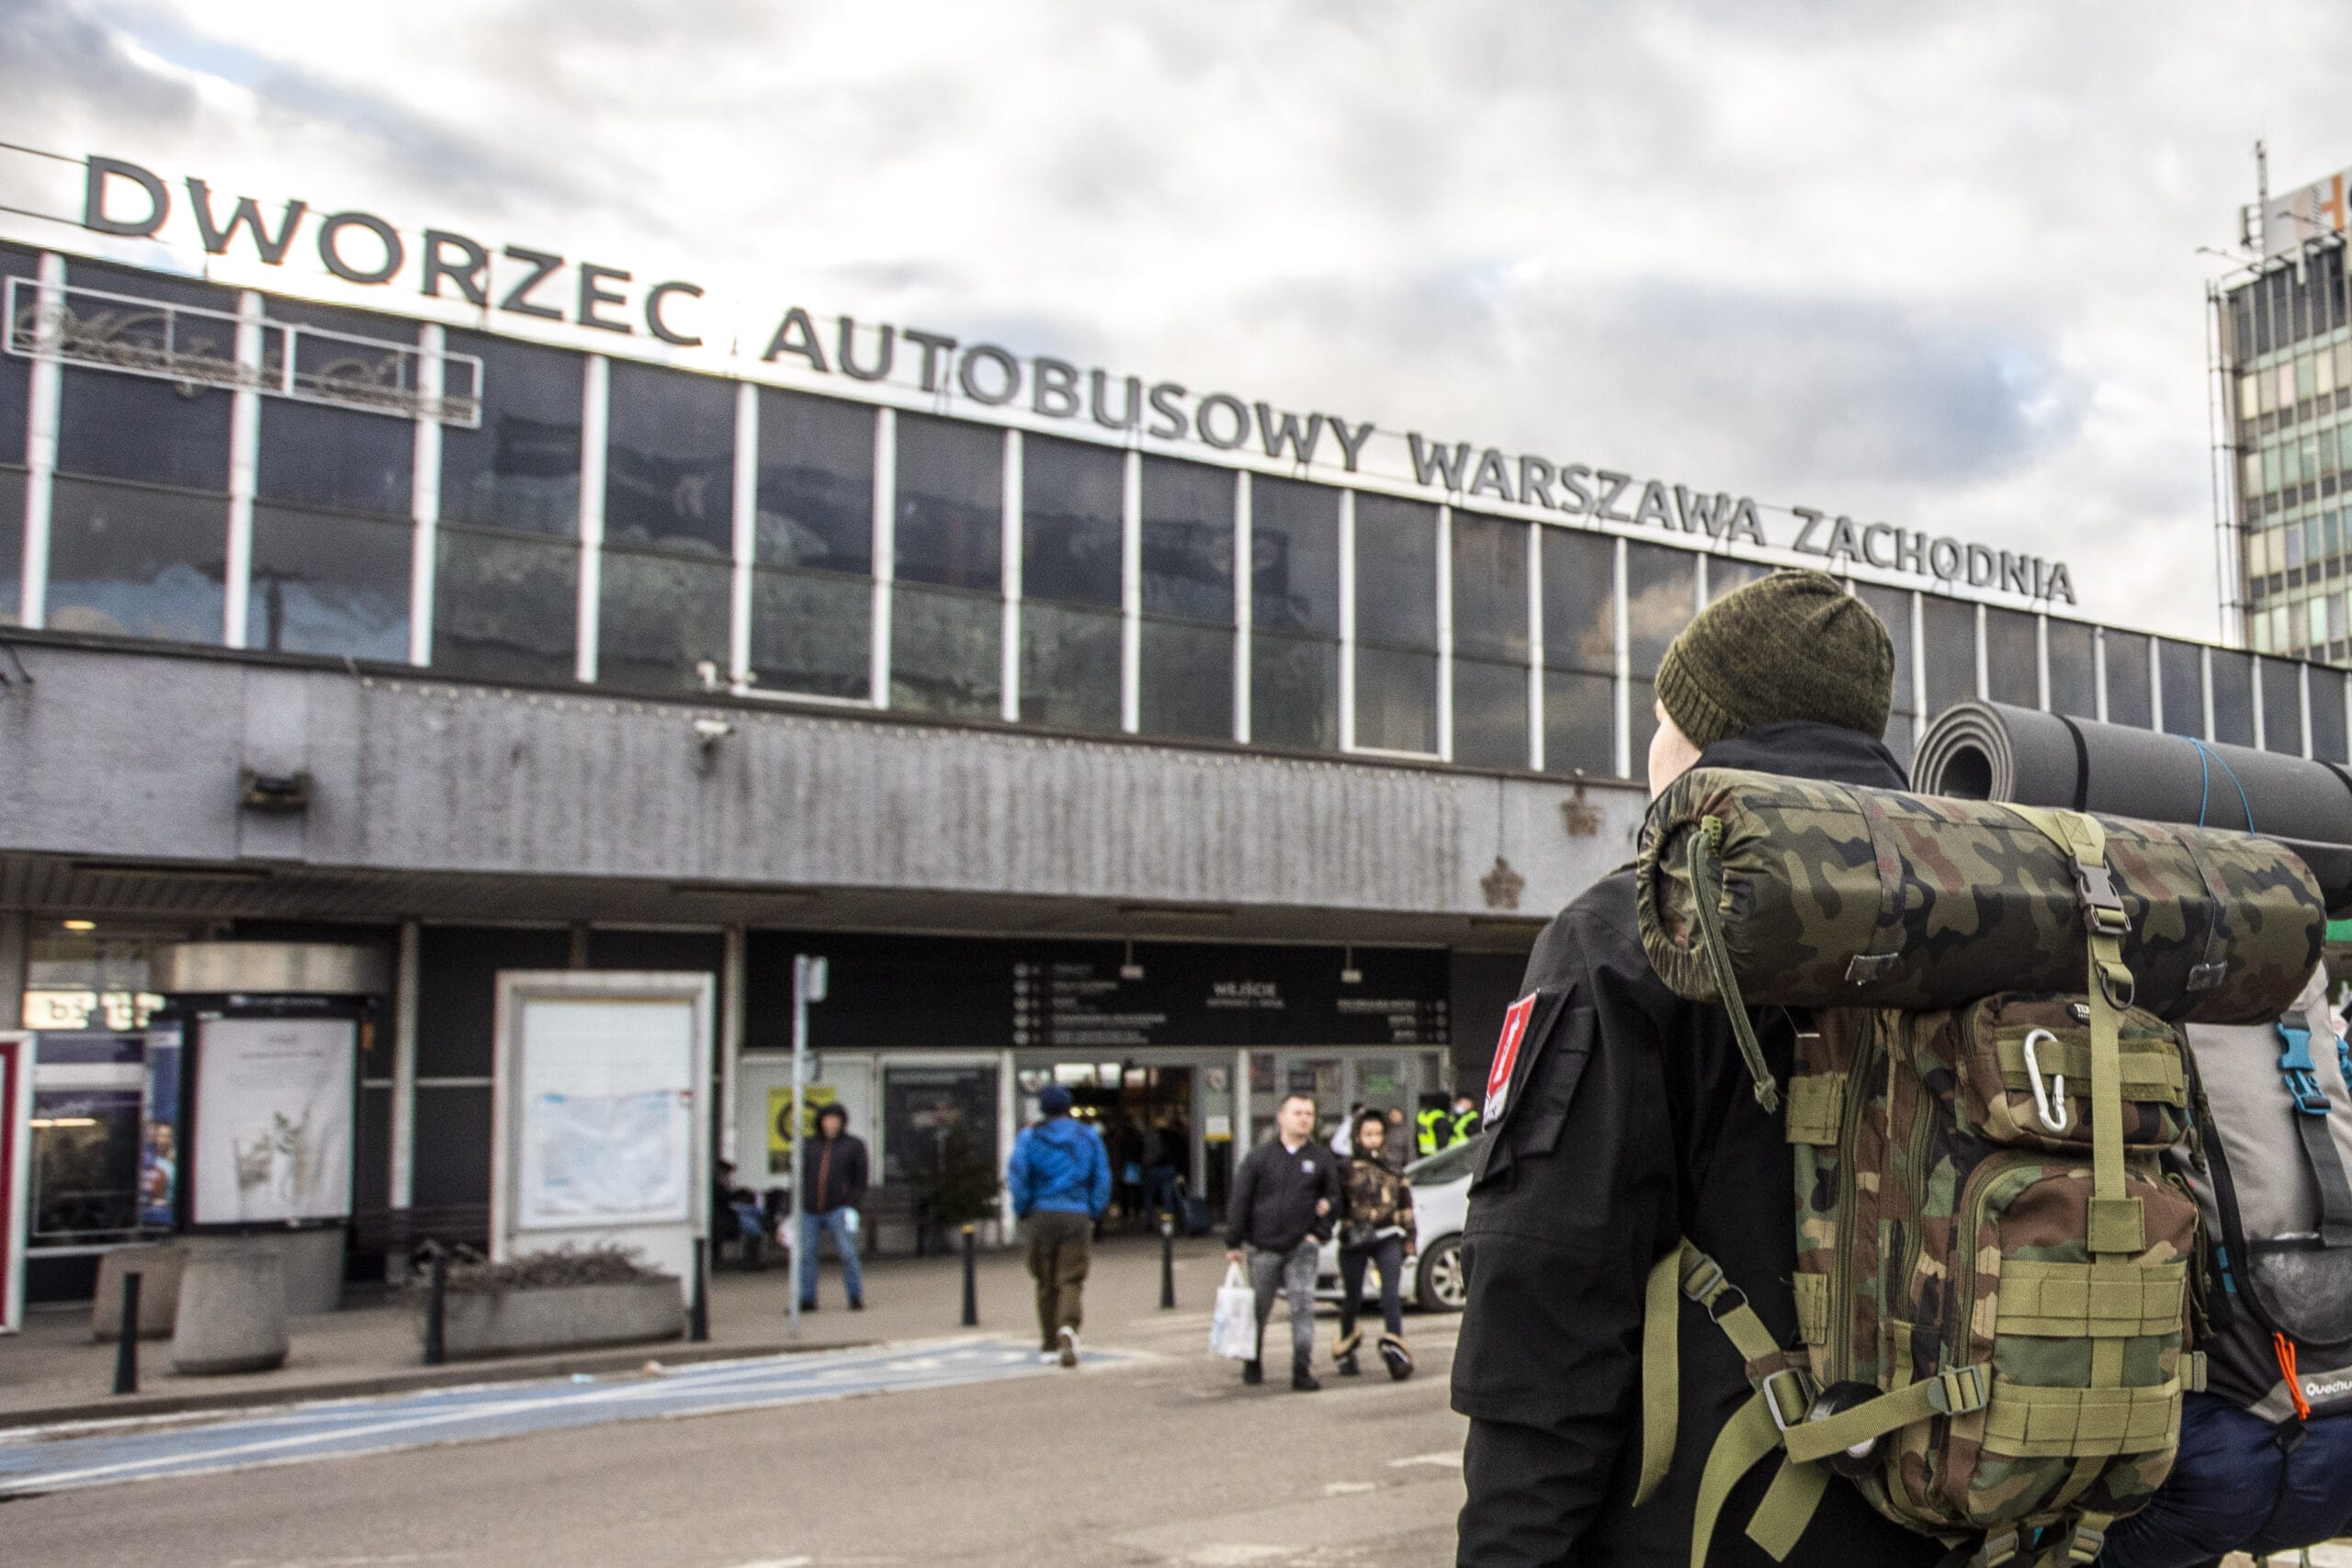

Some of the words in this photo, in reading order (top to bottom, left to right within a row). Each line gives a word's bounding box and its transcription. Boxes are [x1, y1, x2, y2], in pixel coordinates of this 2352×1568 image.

[85, 153, 705, 347] DWORZEC
[762, 307, 1374, 472] AUTOBUSOWY
[1407, 432, 1766, 546] WARSZAWA
[1792, 507, 2077, 605] ZACHODNIA
